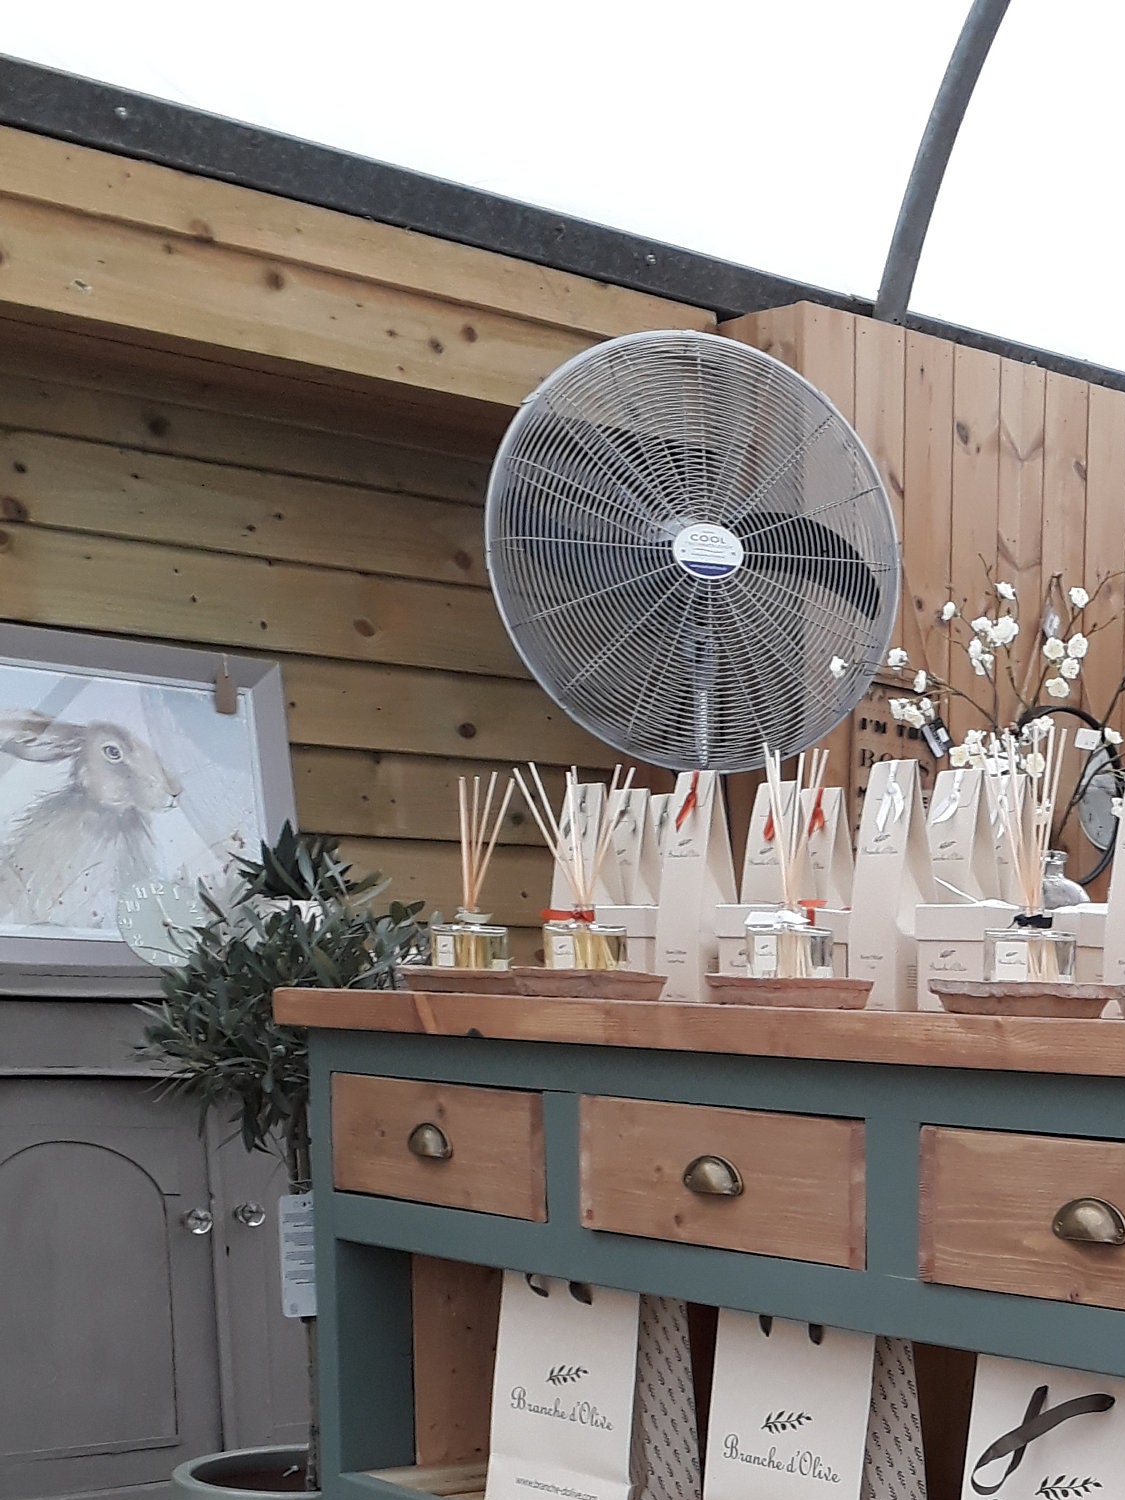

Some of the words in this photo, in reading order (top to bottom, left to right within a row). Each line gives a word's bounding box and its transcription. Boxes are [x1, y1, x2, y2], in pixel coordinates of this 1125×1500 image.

[689, 533, 727, 545] COOL
[859, 717, 887, 734] I'M
[896, 724, 927, 741] TH
[134, 887, 148, 899] 11
[150, 882, 165, 895] 12
[510, 1385, 567, 1420] Branche
[568, 1401, 615, 1431] d'Olive
[723, 1433, 785, 1471] Branche
[786, 1450, 841, 1483] d'Olive
